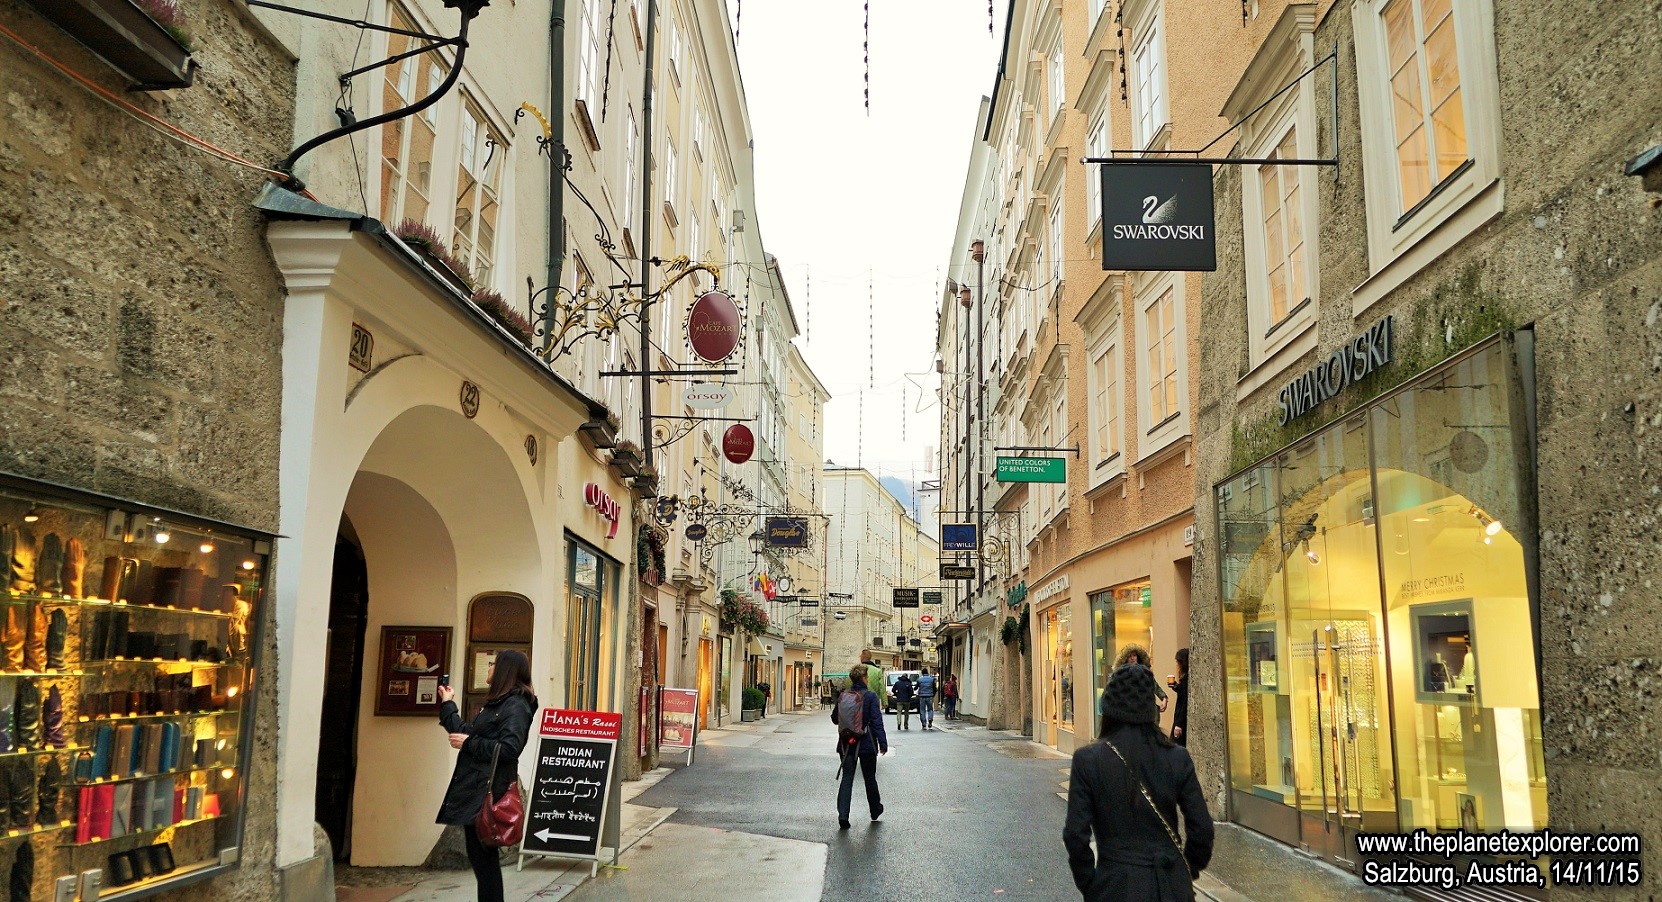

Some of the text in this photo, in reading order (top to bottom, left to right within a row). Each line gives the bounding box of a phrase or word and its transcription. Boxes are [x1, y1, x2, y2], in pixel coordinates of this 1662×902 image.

[1113, 224, 1205, 240] SWAROVSKI
[352, 329, 369, 358] 20
[1277, 315, 1393, 427] SWAROVSKI
[463, 383, 478, 407] 22
[686, 393, 728, 404] orsay
[583, 482, 621, 540] orsay
[1401, 572, 1465, 592] MERRY CHRISTMAS
[575, 728, 616, 737] RESTAURANT
[558, 746, 593, 758] INDIAN
[541, 757, 605, 769] RESTAURANT
